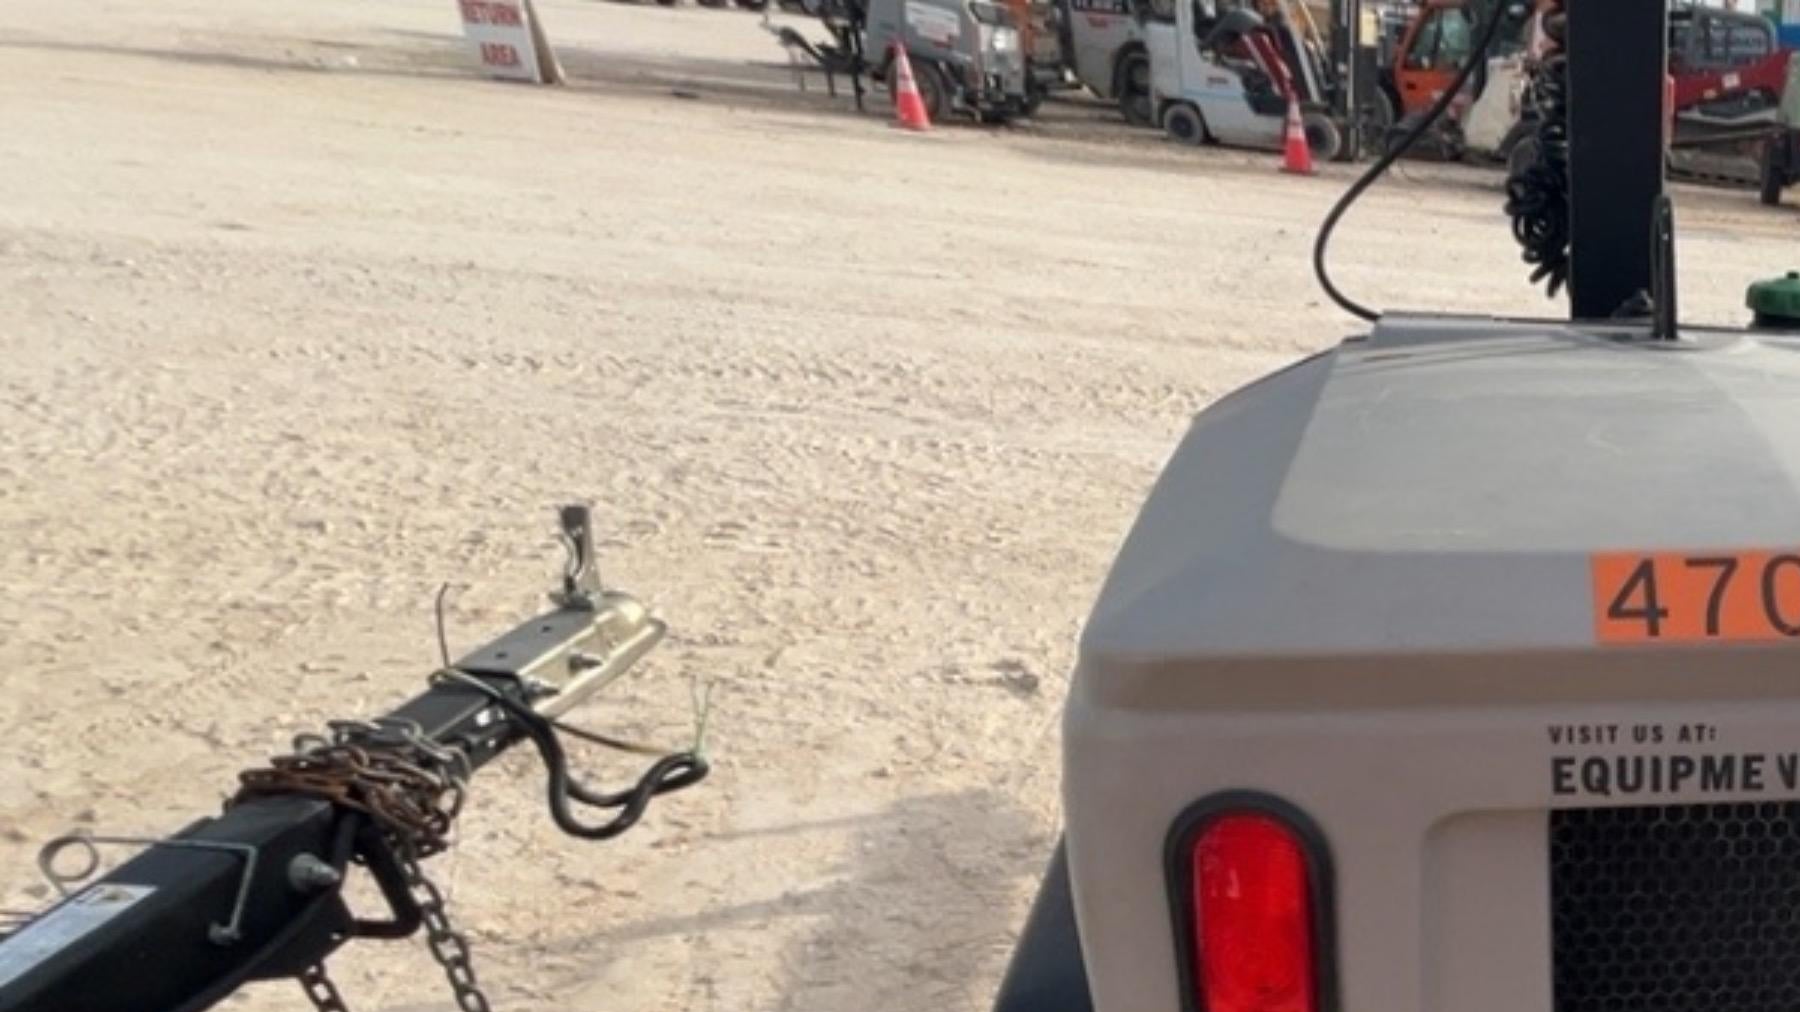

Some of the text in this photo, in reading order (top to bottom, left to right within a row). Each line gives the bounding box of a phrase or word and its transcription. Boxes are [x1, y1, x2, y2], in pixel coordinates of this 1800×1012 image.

[1548, 725, 1717, 744] VISIT US AT:
